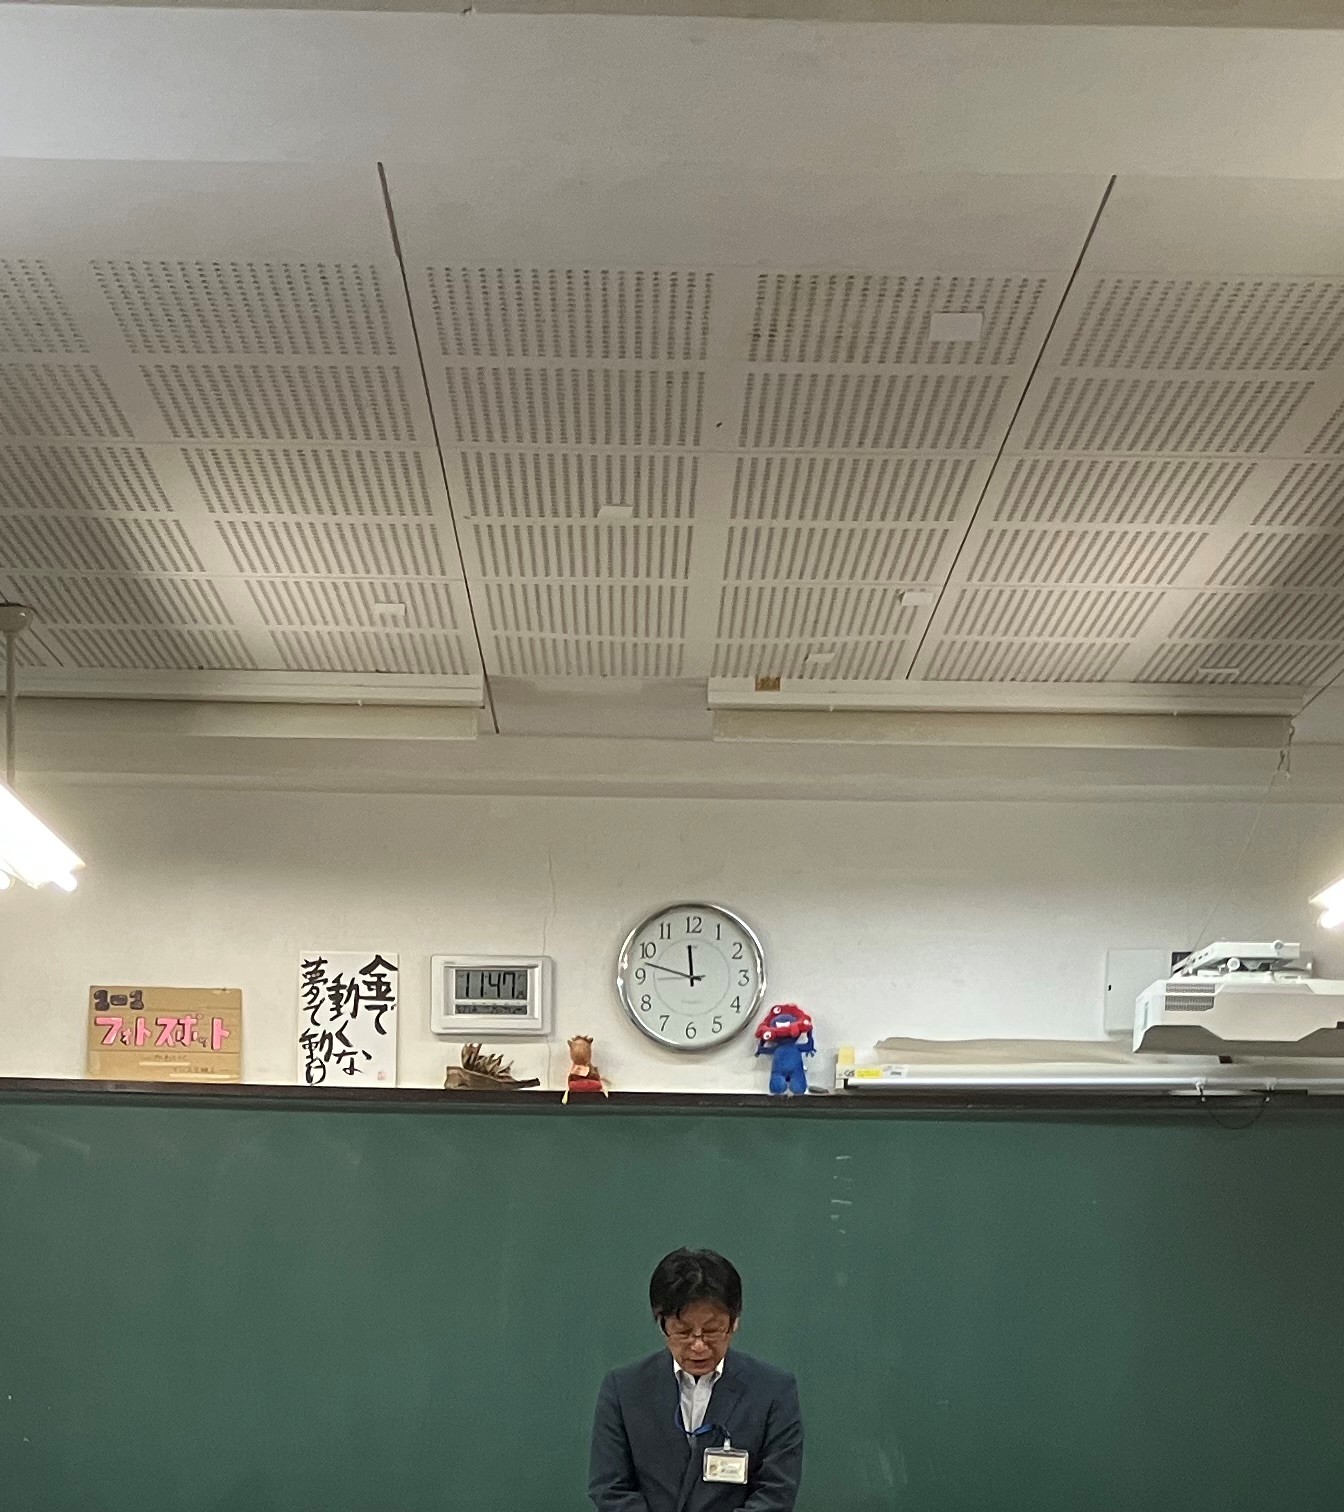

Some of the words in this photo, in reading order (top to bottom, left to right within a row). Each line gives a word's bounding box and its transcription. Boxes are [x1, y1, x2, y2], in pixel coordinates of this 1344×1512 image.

[659, 922, 671, 939] 11
[686, 916, 702, 934] 12
[640, 942, 656, 959] 10
[731, 942, 743, 960] 2
[635, 968, 646, 985] 9
[738, 969, 750, 987] 3
[358, 954, 399, 1035] 金で
[640, 994, 652, 1012] 8
[730, 996, 741, 1014] 4
[94, 1012, 230, 1051] フォトスポット
[326, 972, 373, 1076] 動くな
[659, 1015, 670, 1032] 7
[685, 1022, 697, 1039] 6
[712, 1015, 723, 1033] 5
